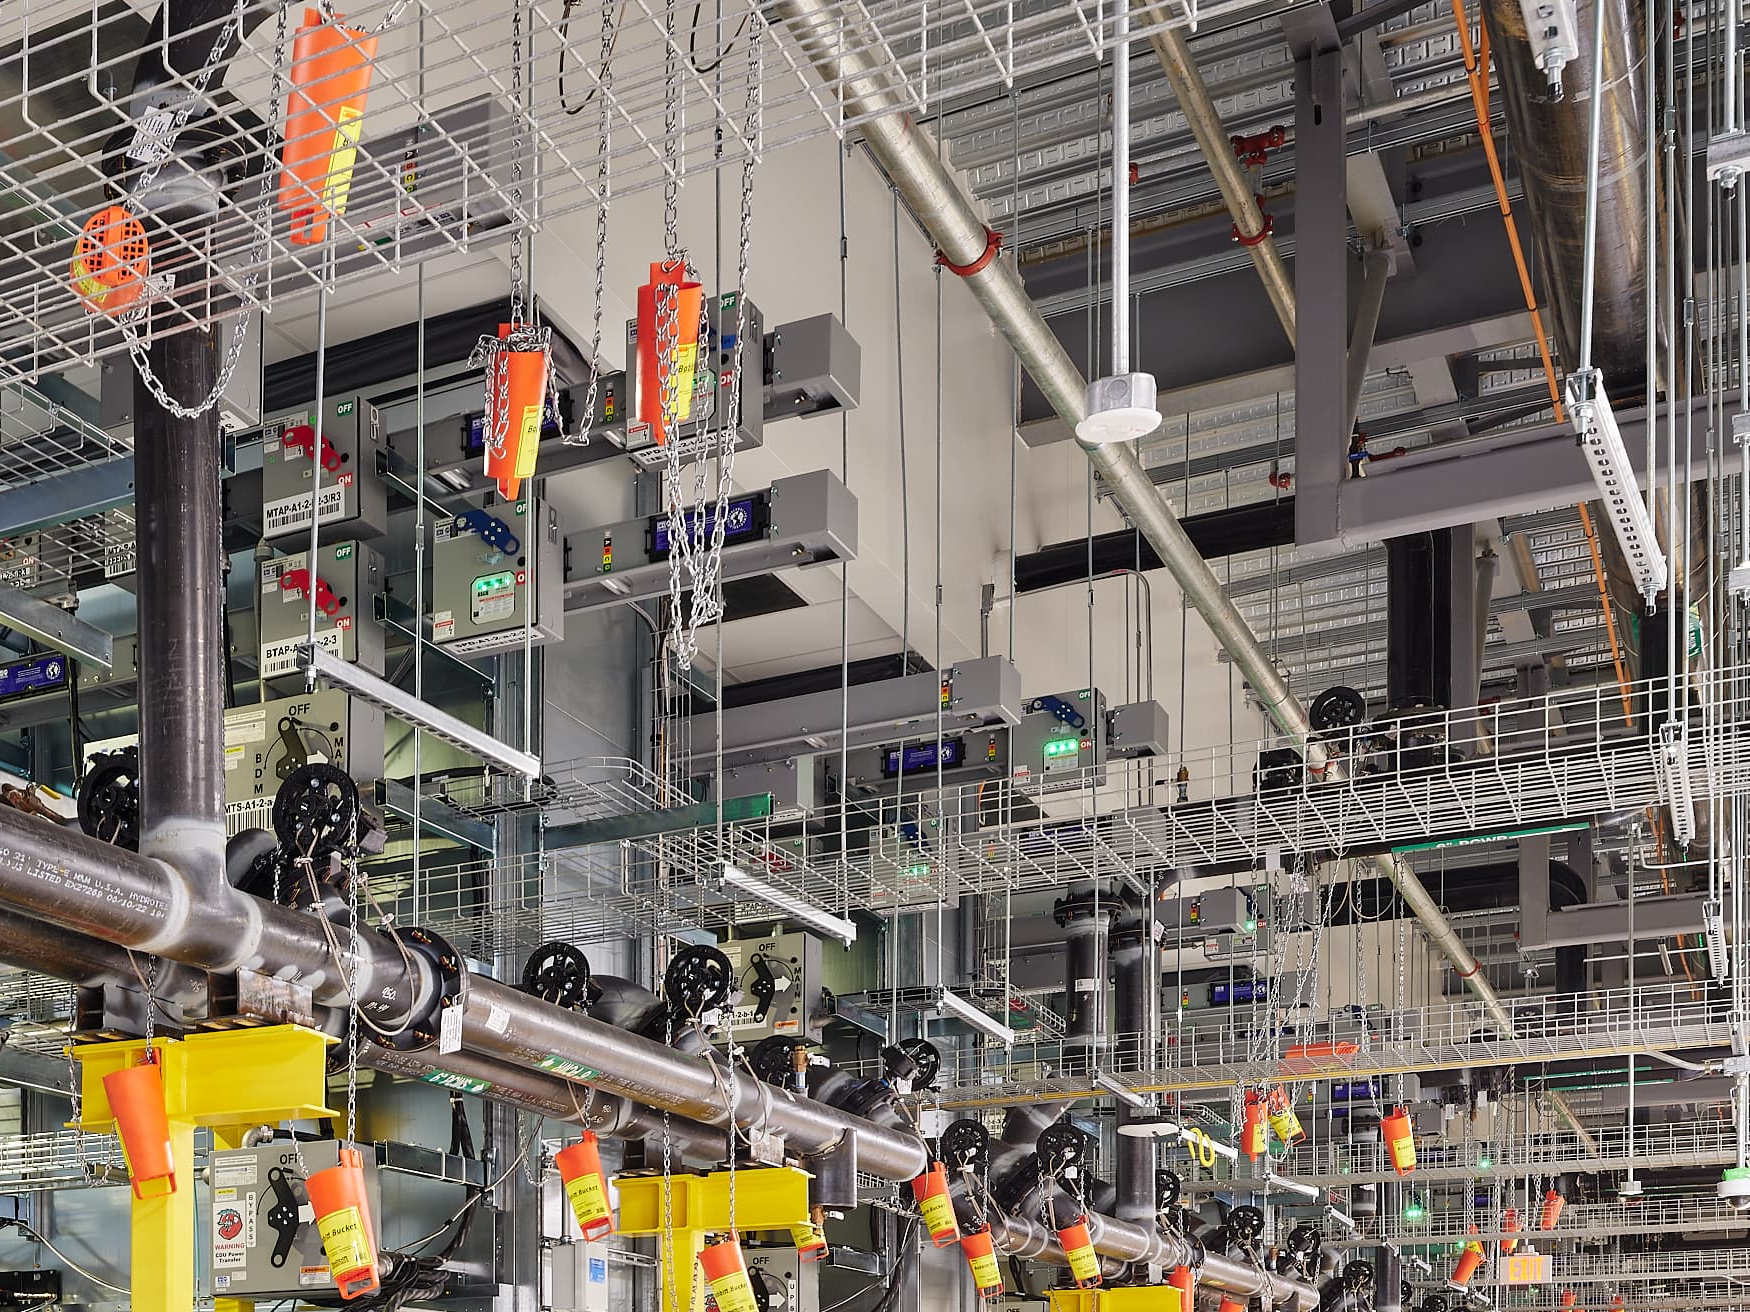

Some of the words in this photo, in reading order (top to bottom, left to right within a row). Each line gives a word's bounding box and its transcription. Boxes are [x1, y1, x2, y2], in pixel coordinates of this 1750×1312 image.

[337, 403, 352, 414] OFF
[338, 474, 351, 485] ON
[336, 547, 351, 558] OFF
[336, 618, 350, 628] ON
[288, 703, 311, 716] OFF
[26, 866, 62, 885] LISTED
[758, 943, 776, 951] OFF
[332, 1222, 358, 1237] Bucket
[214, 1242, 245, 1250] WARNING
[752, 1256, 770, 1265] OFF
[1509, 1256, 1543, 1281] EXIT
